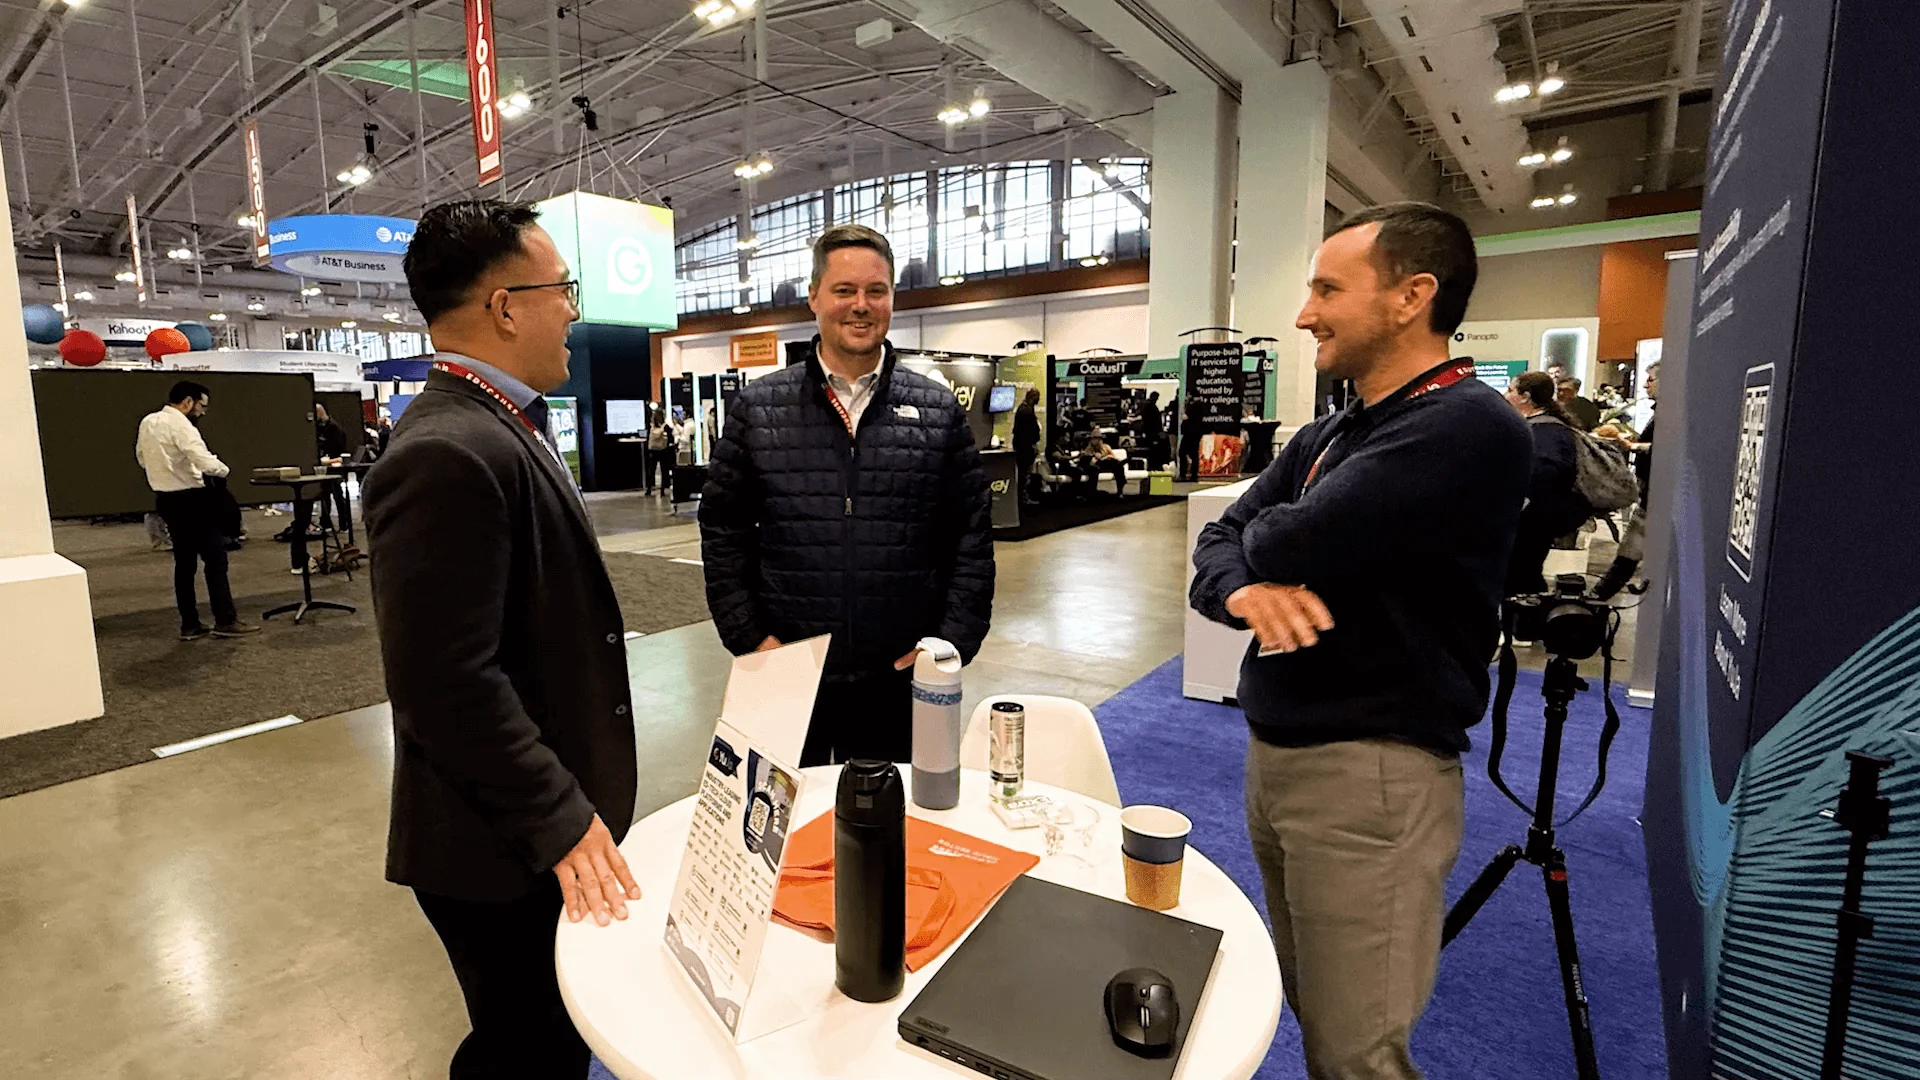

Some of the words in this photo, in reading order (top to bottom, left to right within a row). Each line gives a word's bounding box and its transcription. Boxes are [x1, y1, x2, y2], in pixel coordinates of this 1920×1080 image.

[476, 0, 494, 143] 1600
[249, 129, 266, 237] 1500
[321, 256, 342, 267] AT&T
[344, 257, 386, 271] Business
[1467, 333, 1499, 342] Panopto
[1191, 348, 1240, 358] Purpose-built
[1200, 358, 1228, 367] services
[1229, 358, 1240, 366] for
[1080, 362, 1128, 374] OculusIT
[1203, 368, 1227, 377] higher
[1196, 378, 1233, 386] education.
[465, 372, 519, 415] EDUCAUSE
[1224, 386, 1233, 396] by
[1210, 395, 1240, 406] colleges
[1210, 405, 1218, 413] &
